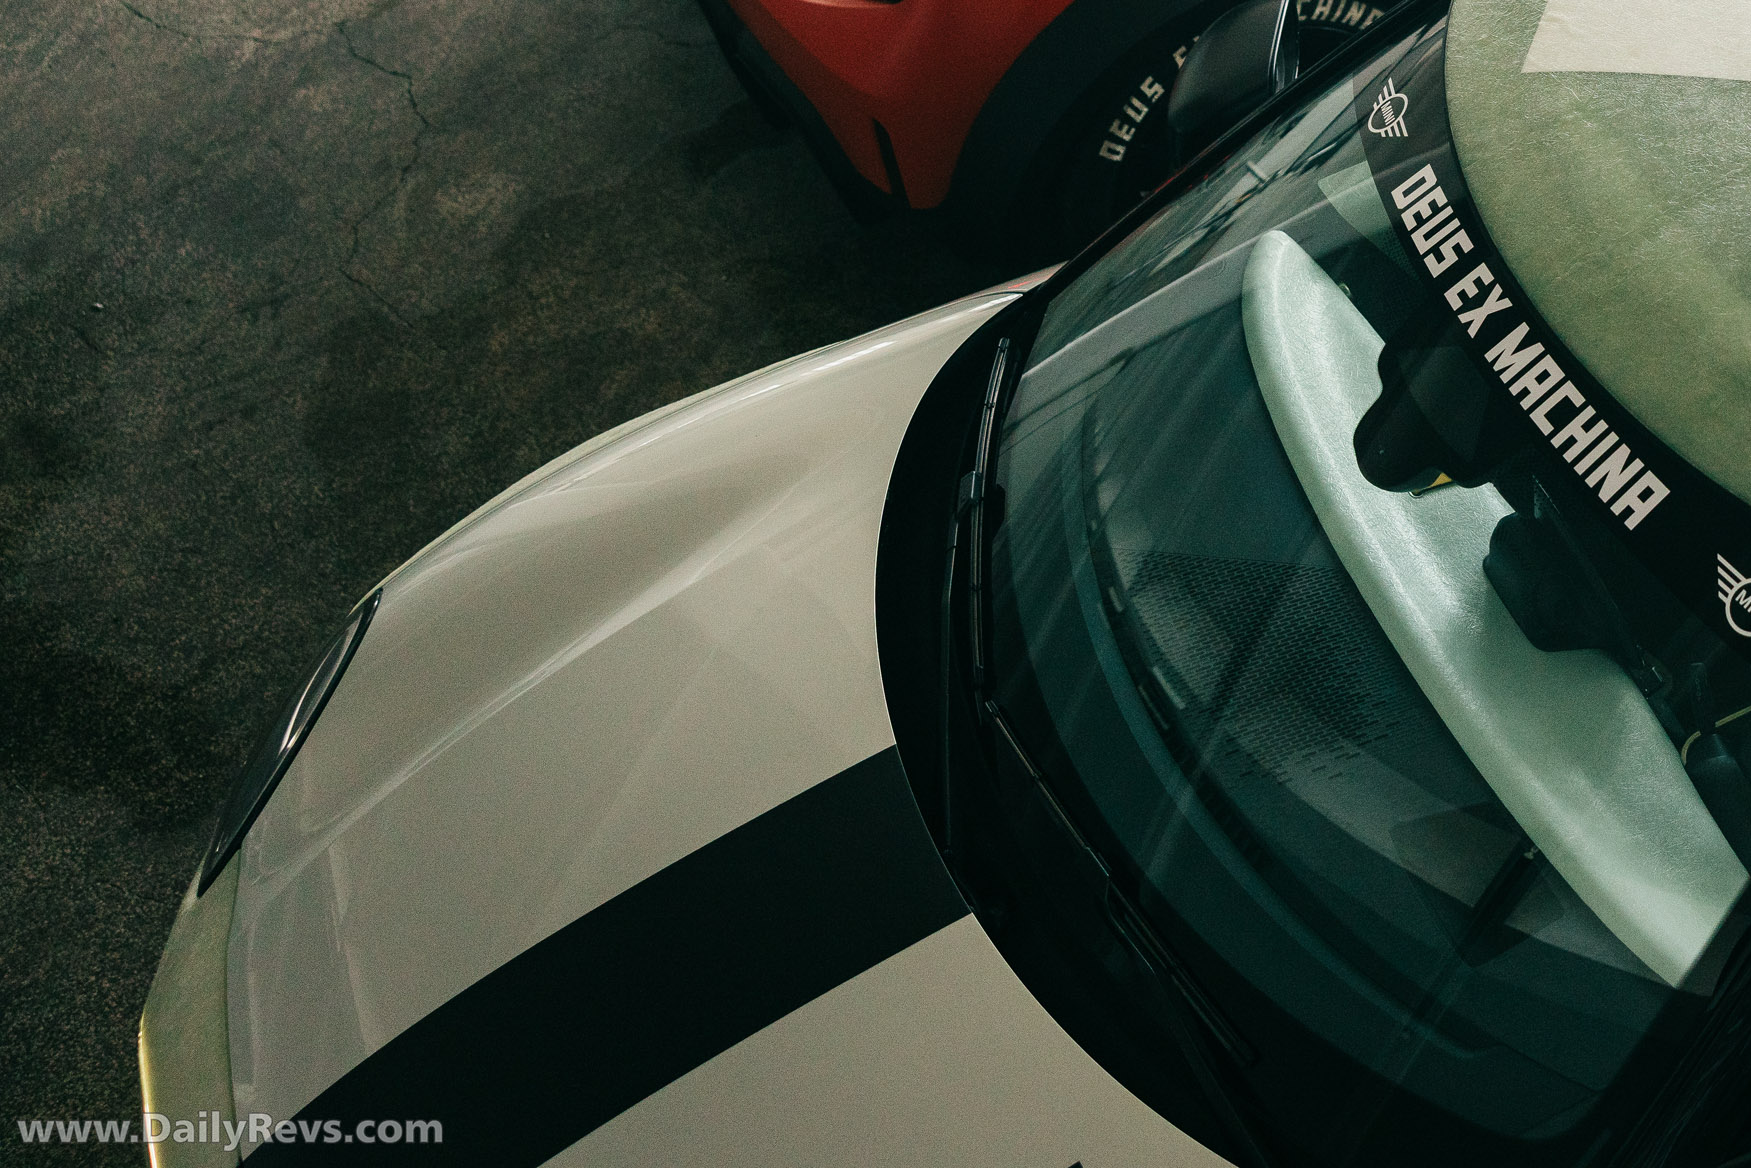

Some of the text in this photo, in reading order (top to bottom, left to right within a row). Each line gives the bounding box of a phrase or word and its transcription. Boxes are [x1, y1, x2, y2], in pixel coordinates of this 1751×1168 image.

[1098, 75, 1165, 161] DEUS
[1380, 101, 1396, 126] MINI
[1391, 164, 1671, 531] DEUS EX MACHINA
